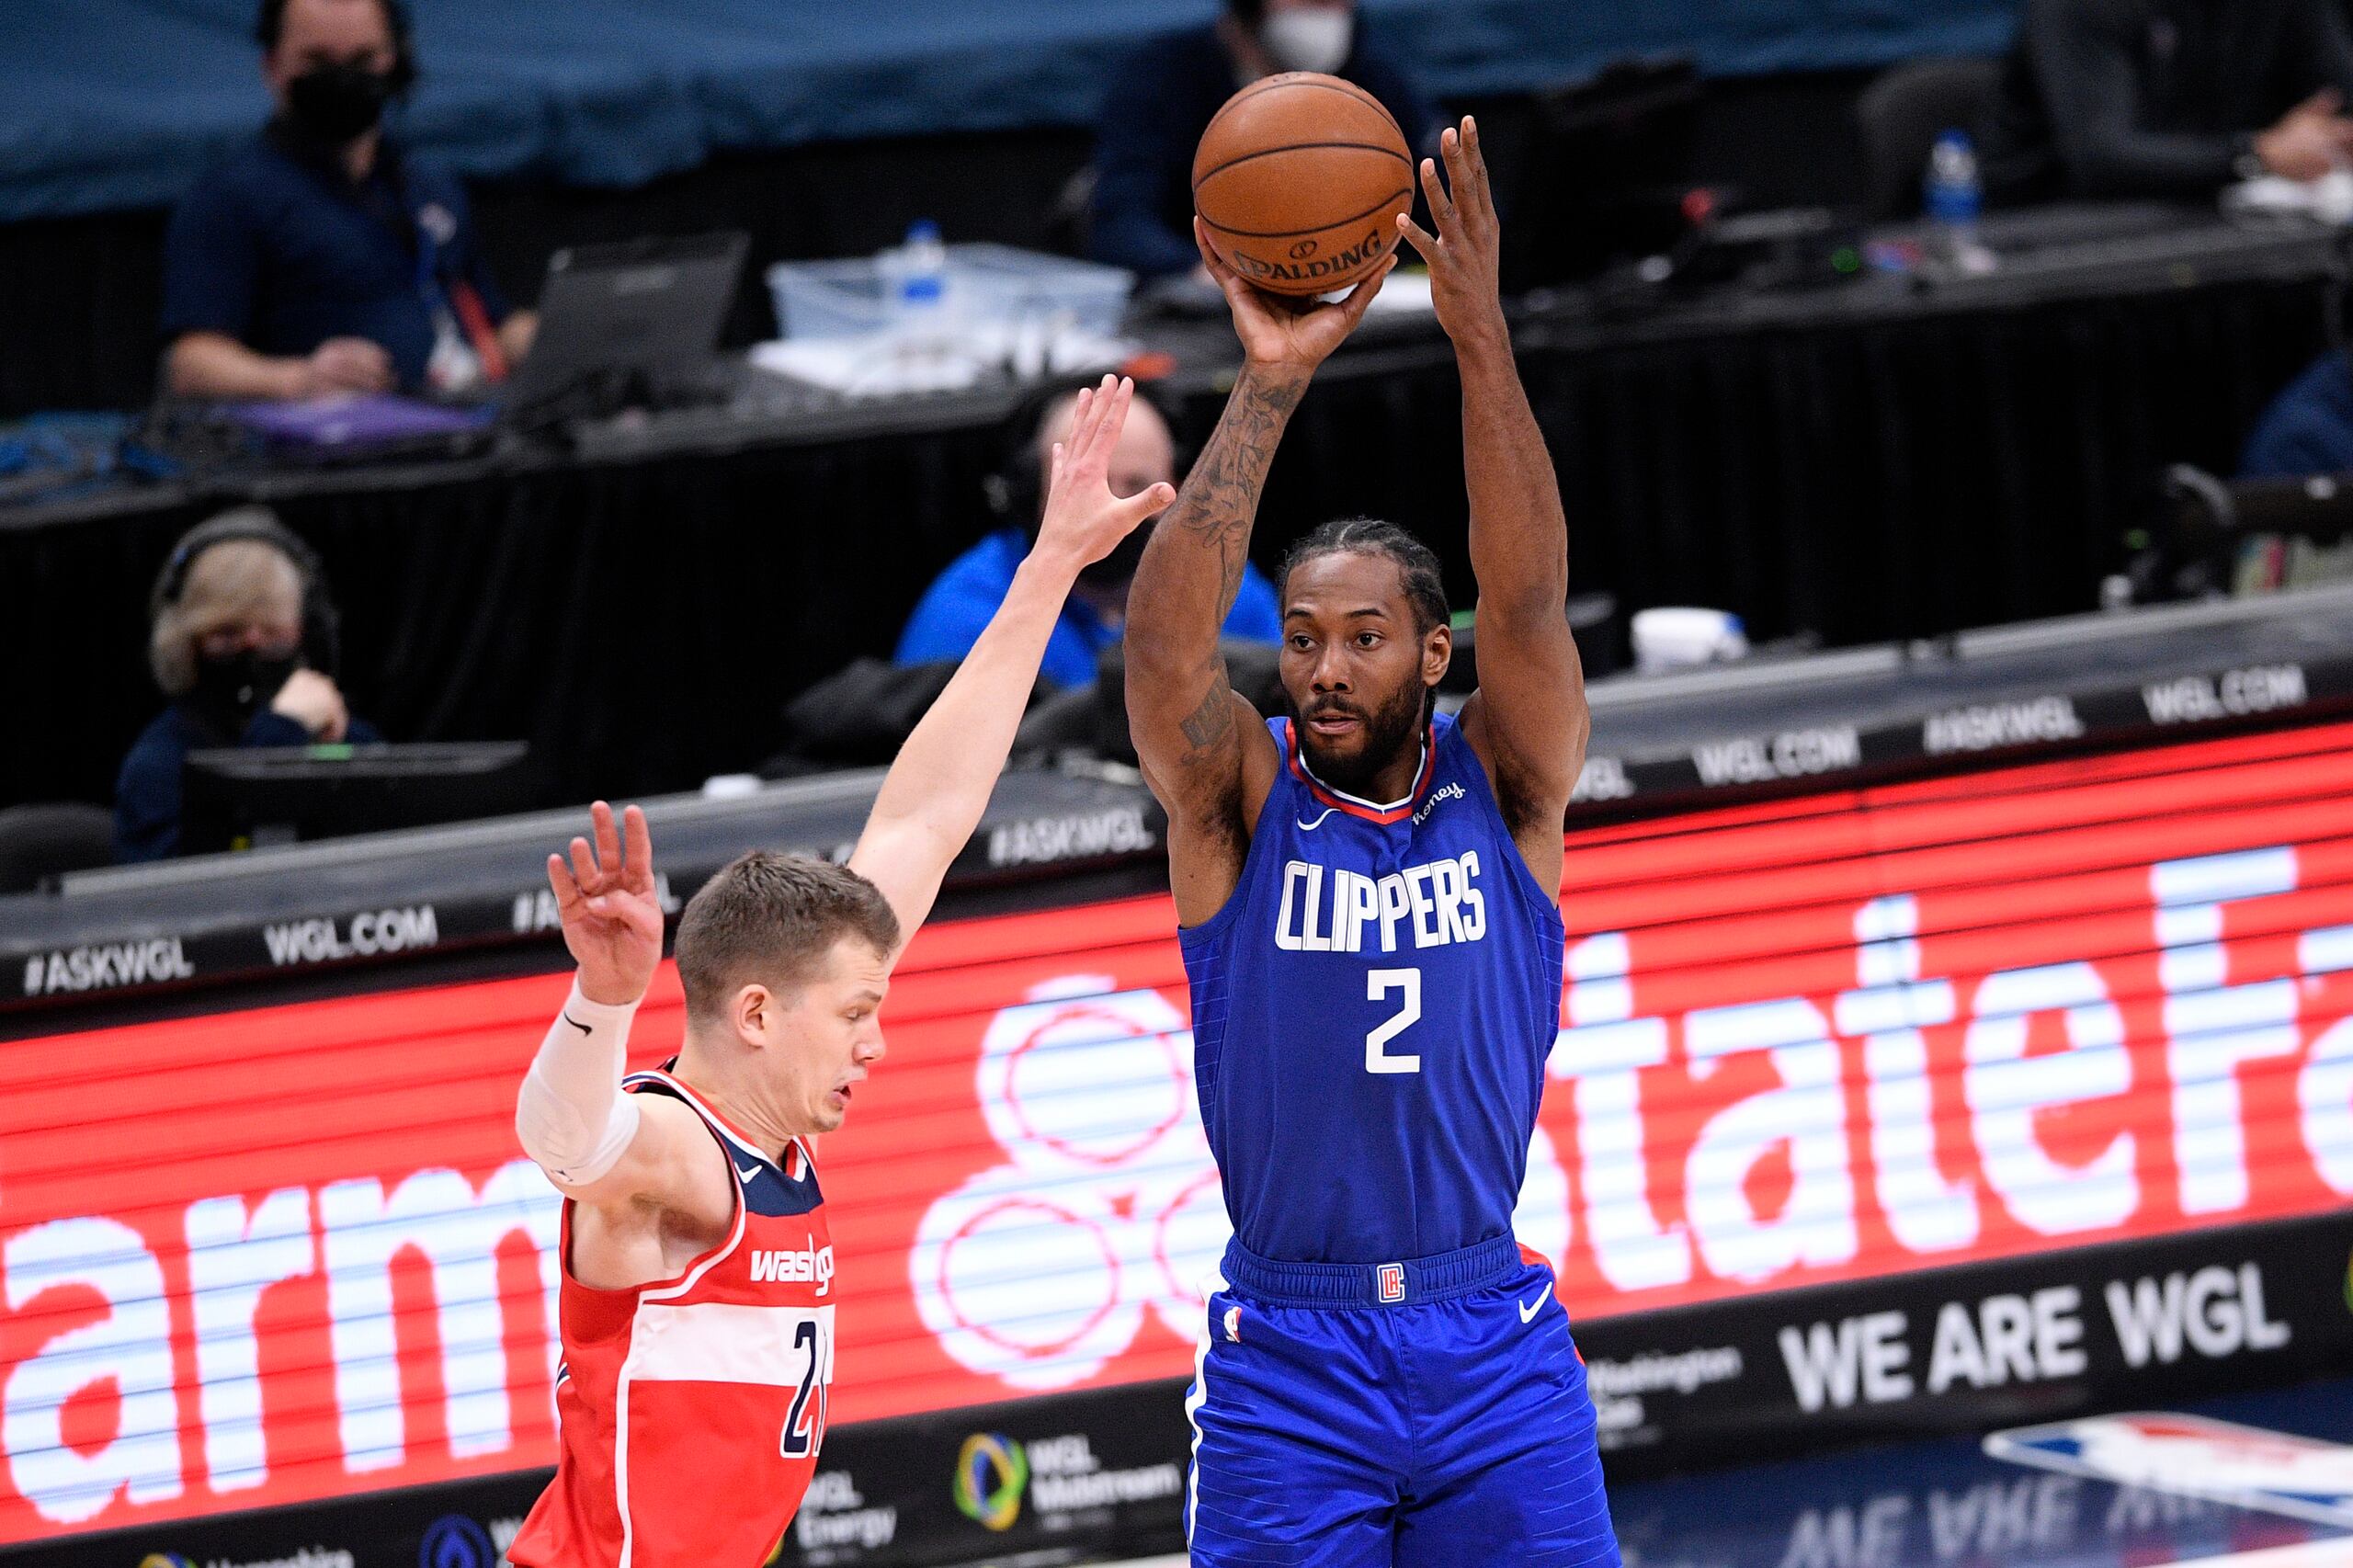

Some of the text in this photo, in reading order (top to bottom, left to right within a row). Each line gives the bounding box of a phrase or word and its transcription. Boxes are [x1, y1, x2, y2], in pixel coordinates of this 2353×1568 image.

[1233, 229, 1382, 279] SPALDING
[1412, 781, 1466, 825] honey
[1275, 850, 1486, 952] CLIPPERS
[263, 904, 439, 965] WGL.COM
[24, 937, 196, 996] #ASKWGL
[1365, 968, 1421, 1074] 2
[1778, 1260, 2291, 1414] WE ARE WGL
